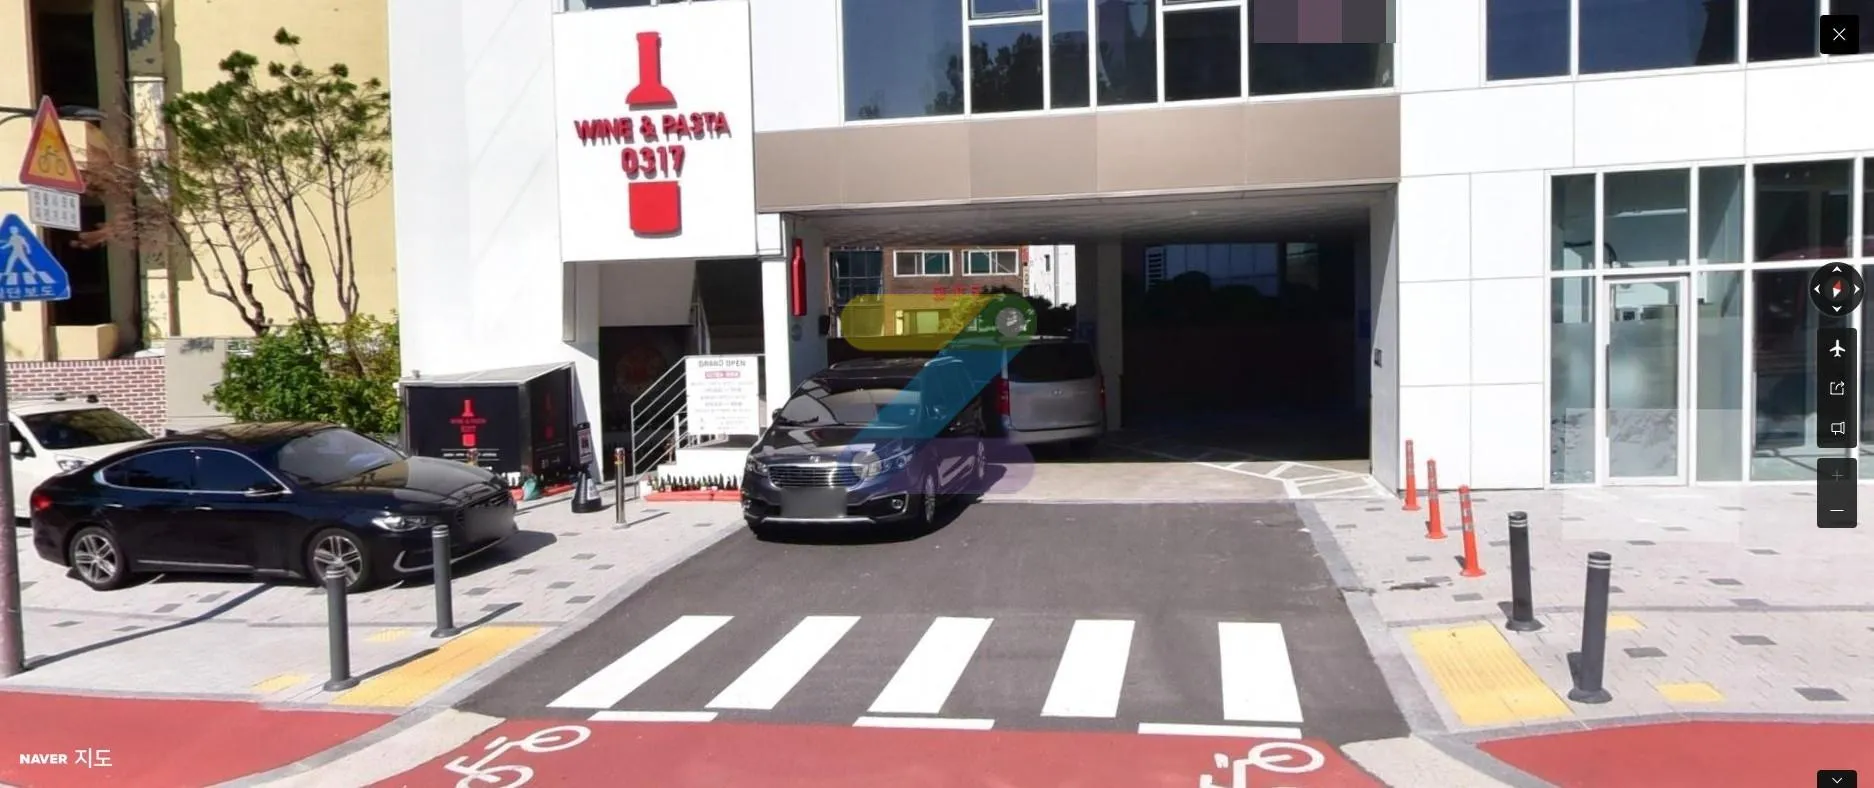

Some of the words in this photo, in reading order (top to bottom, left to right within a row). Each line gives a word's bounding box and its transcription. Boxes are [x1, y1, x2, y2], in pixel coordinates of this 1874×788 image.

[574, 117, 633, 145] WINE
[639, 115, 658, 142] &
[662, 112, 731, 140] PASTA
[621, 145, 685, 178] 0317
